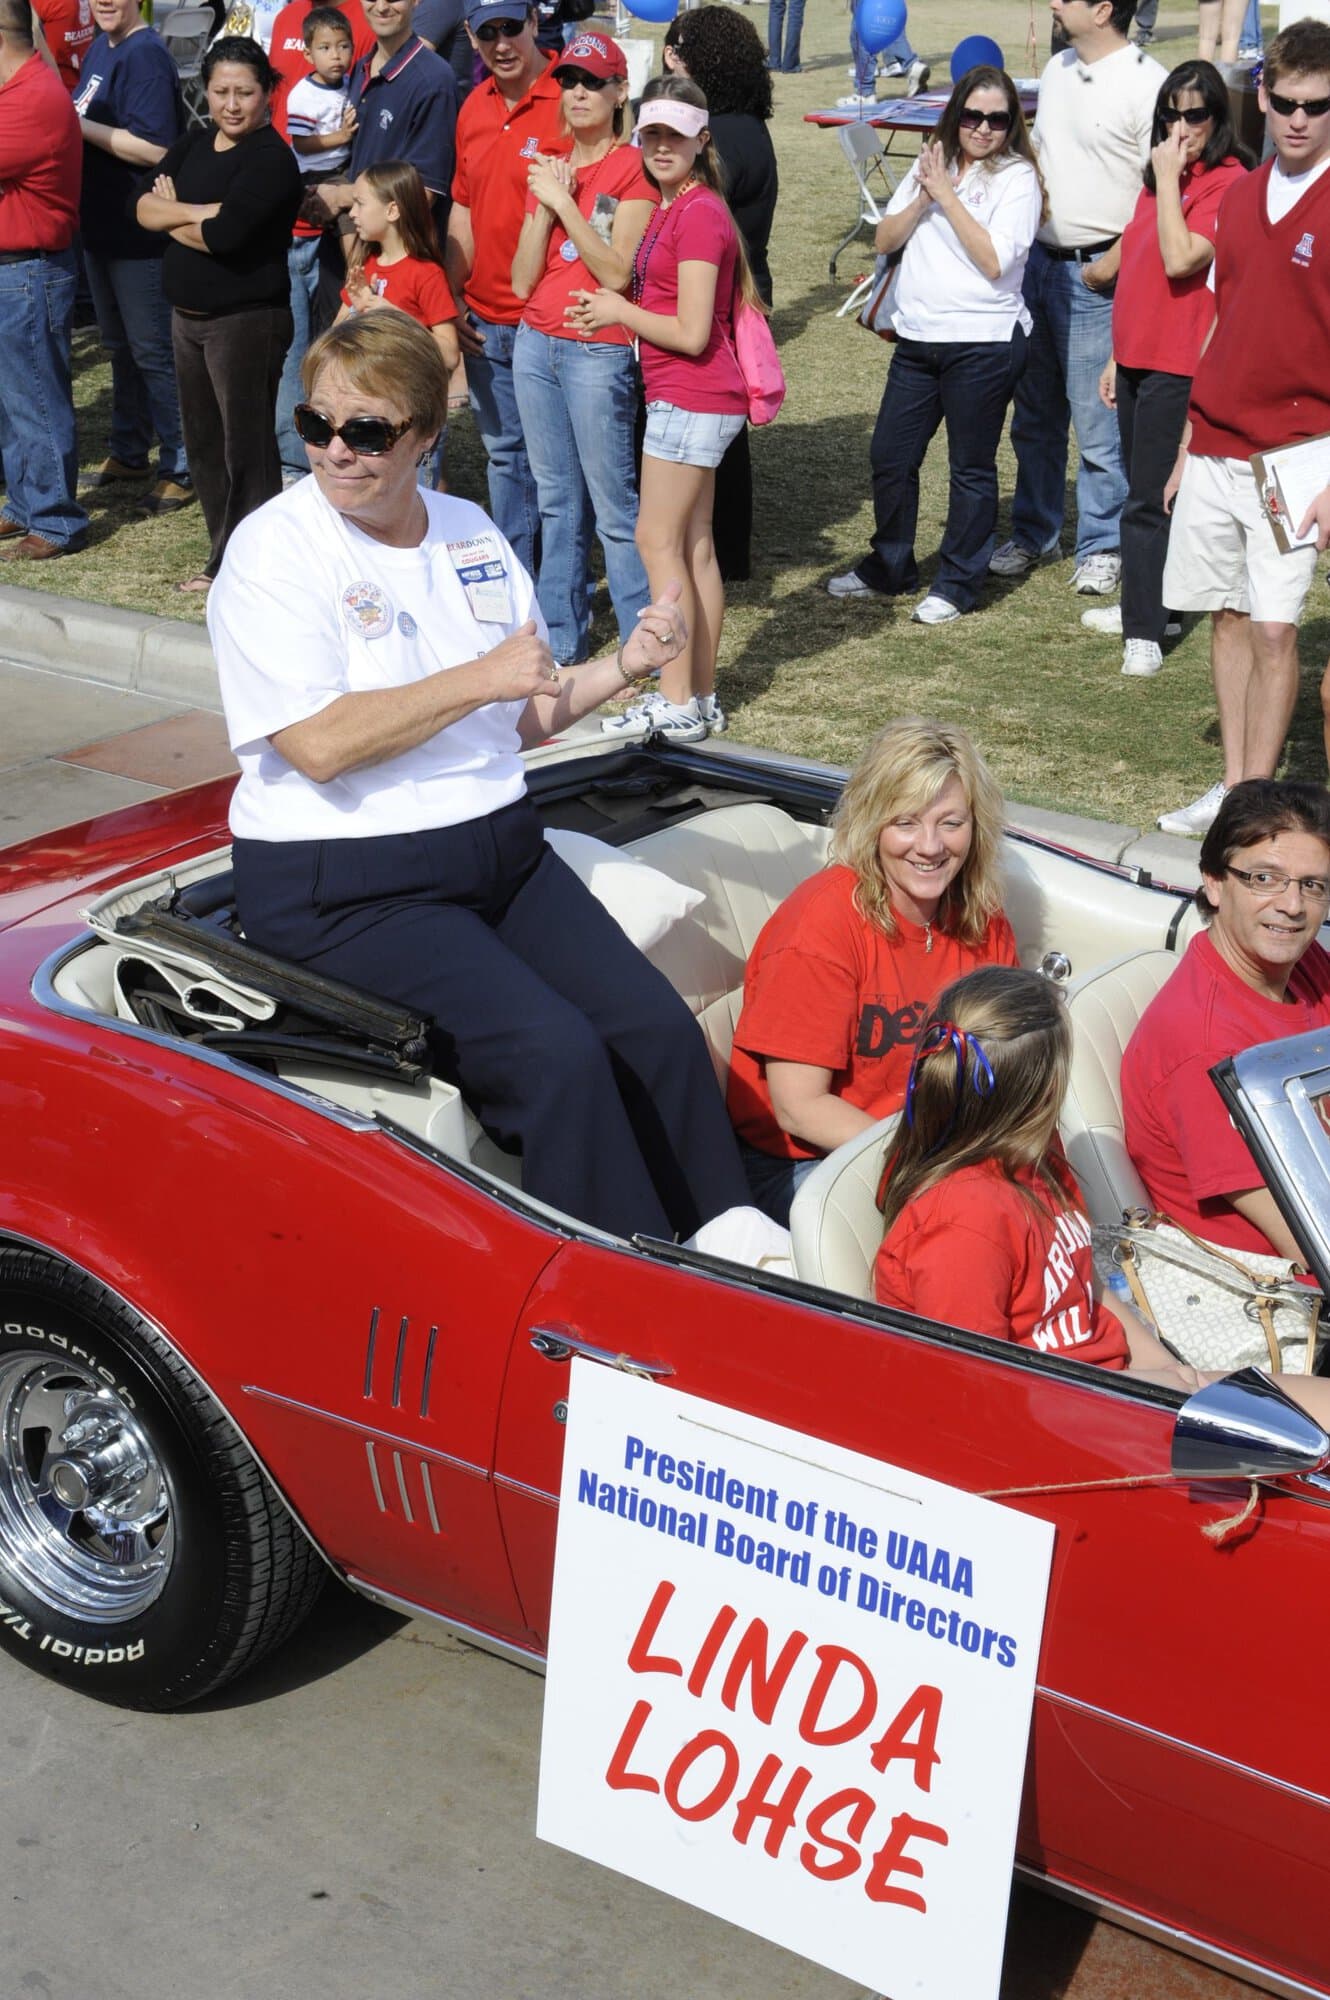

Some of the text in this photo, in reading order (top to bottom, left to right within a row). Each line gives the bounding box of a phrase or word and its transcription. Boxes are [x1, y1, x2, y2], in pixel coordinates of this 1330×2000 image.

[0, 1323, 136, 1408] oodrich
[1032, 1282, 1093, 1352] WIL
[577, 1471, 1017, 1668] National Board of Directors
[624, 1436, 974, 1598] President of the UAAA
[39, 1634, 146, 1666] Radial
[627, 1580, 943, 1792] LINDA
[606, 1700, 949, 1912] LOHSE
